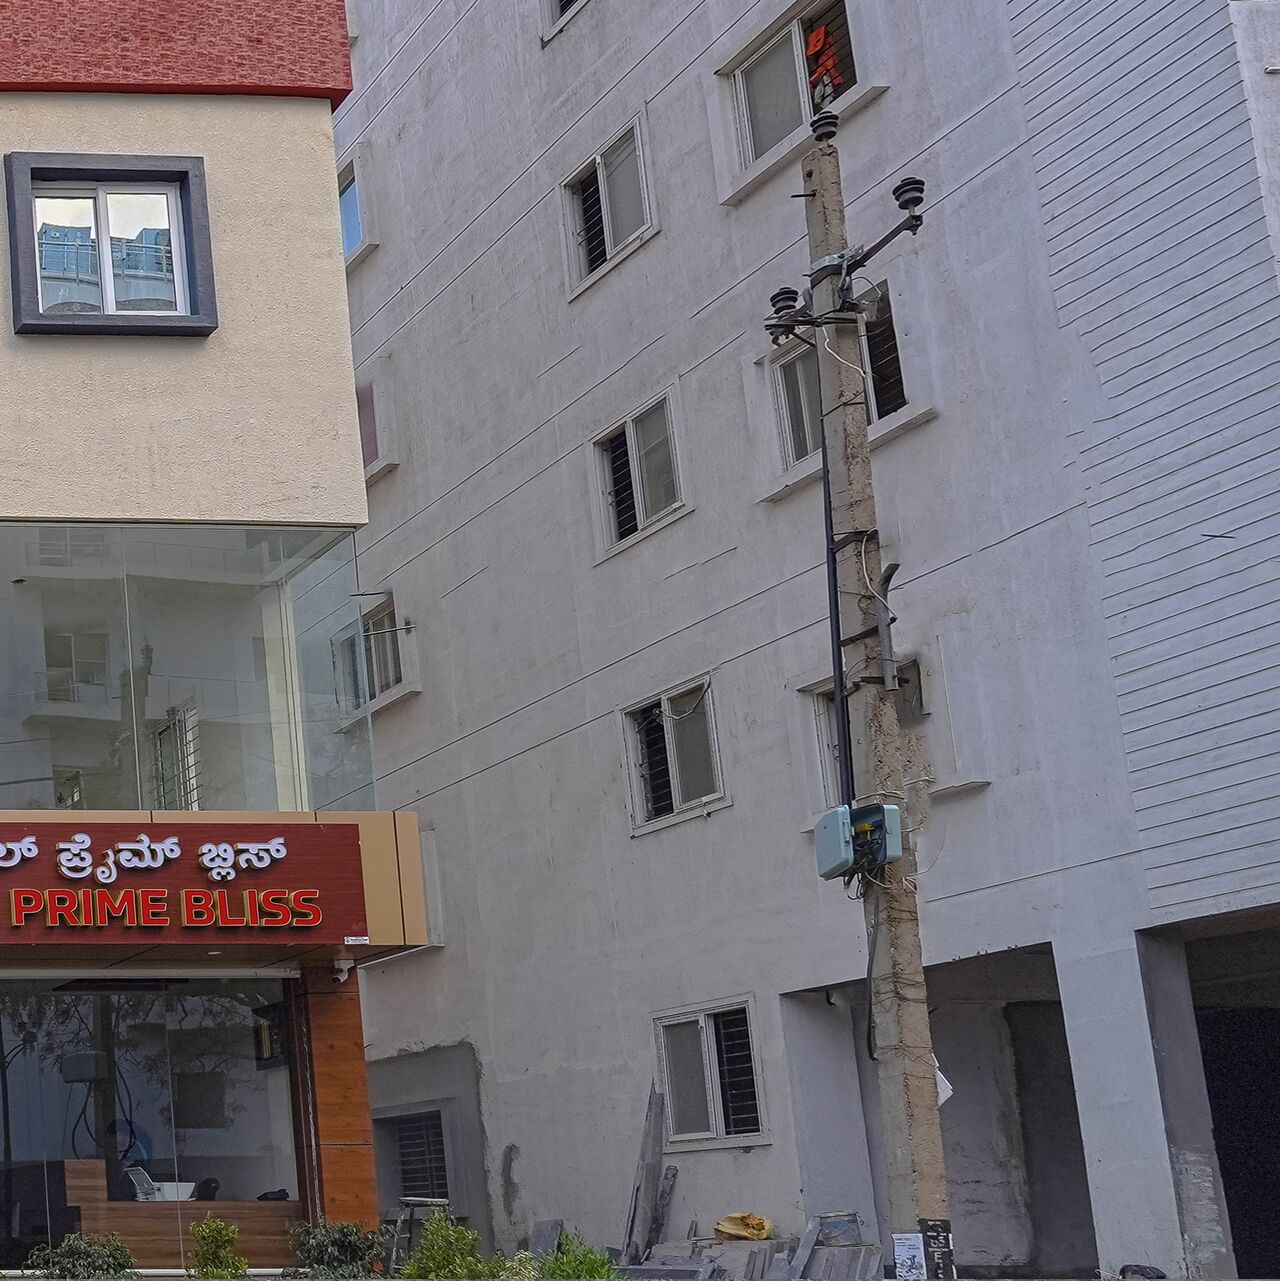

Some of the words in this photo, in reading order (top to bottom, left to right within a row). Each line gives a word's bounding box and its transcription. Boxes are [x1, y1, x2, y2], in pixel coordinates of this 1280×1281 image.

[197, 836, 288, 882] ಬ್ಲಿಸ್
[10, 887, 171, 928] PRIME
[180, 888, 323, 928] BLISS
